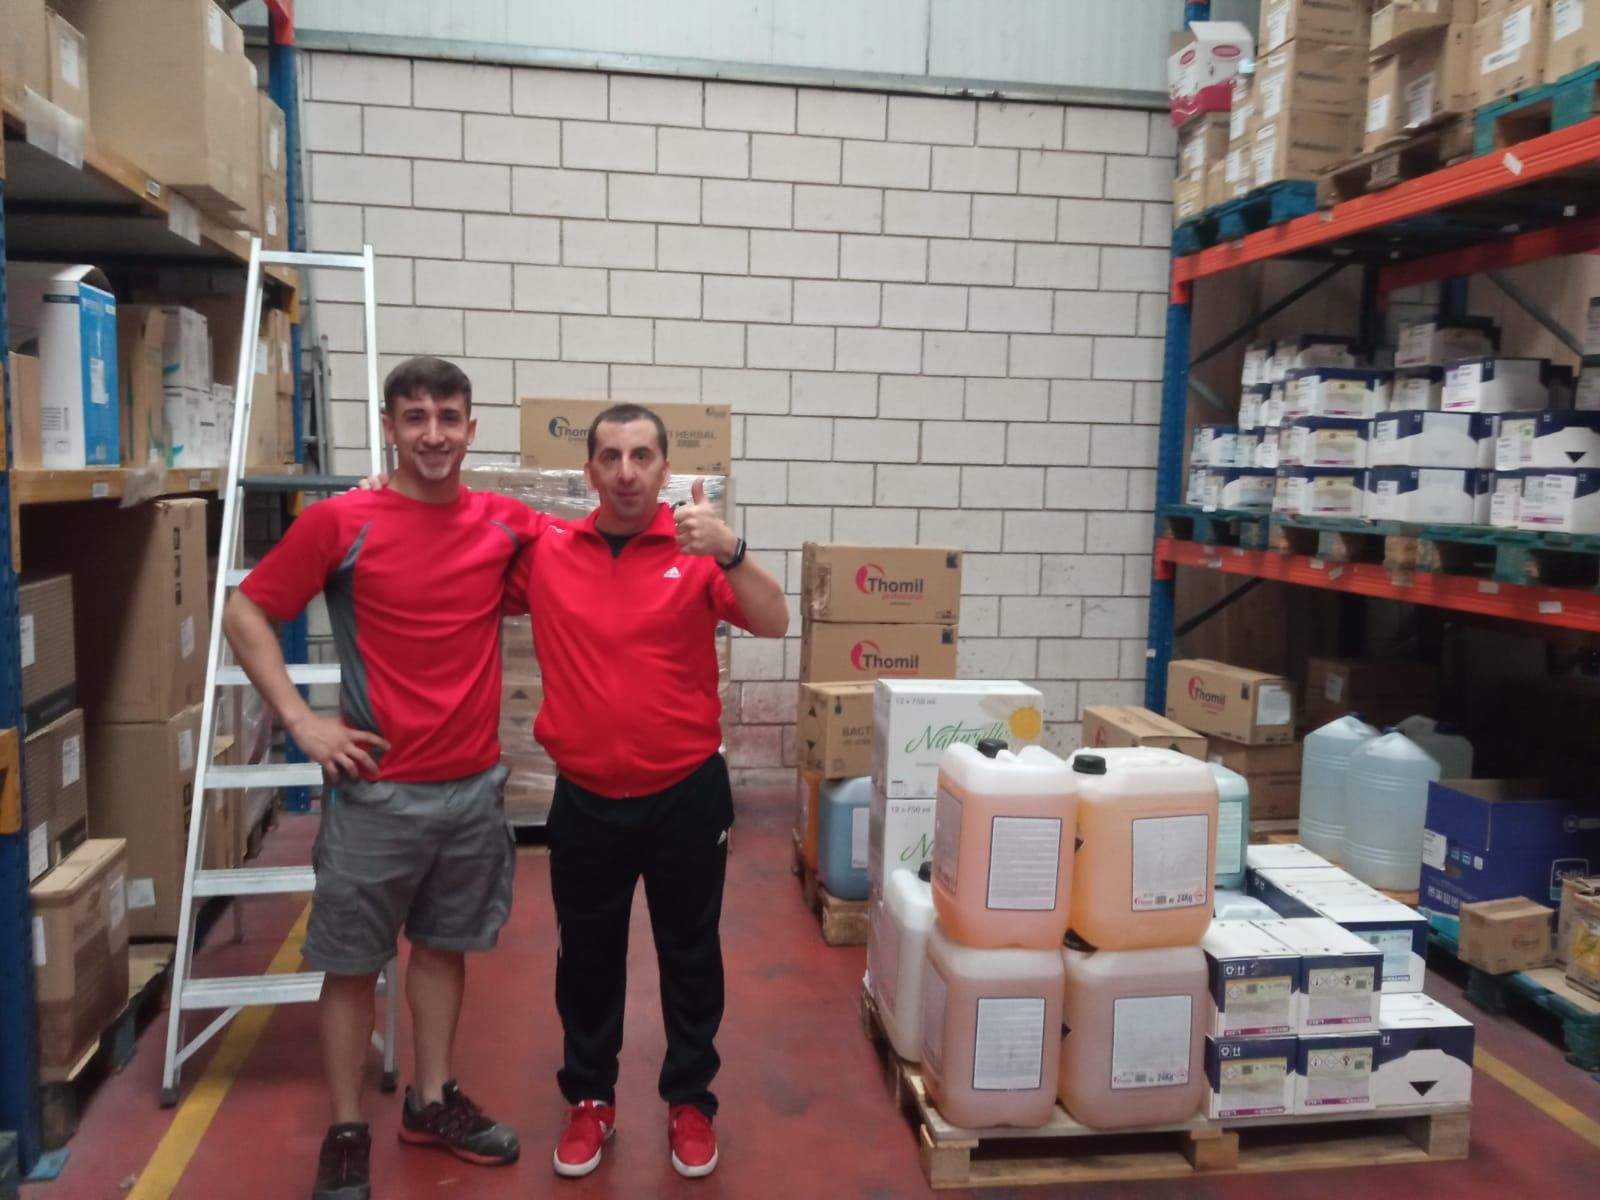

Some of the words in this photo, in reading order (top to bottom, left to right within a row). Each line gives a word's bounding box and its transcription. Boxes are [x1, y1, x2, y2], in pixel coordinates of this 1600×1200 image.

[868, 578, 924, 593] Thomil
[863, 654, 919, 669] Thomil
[1195, 687, 1226, 705] Thomil
[842, 726, 872, 737] BACT
